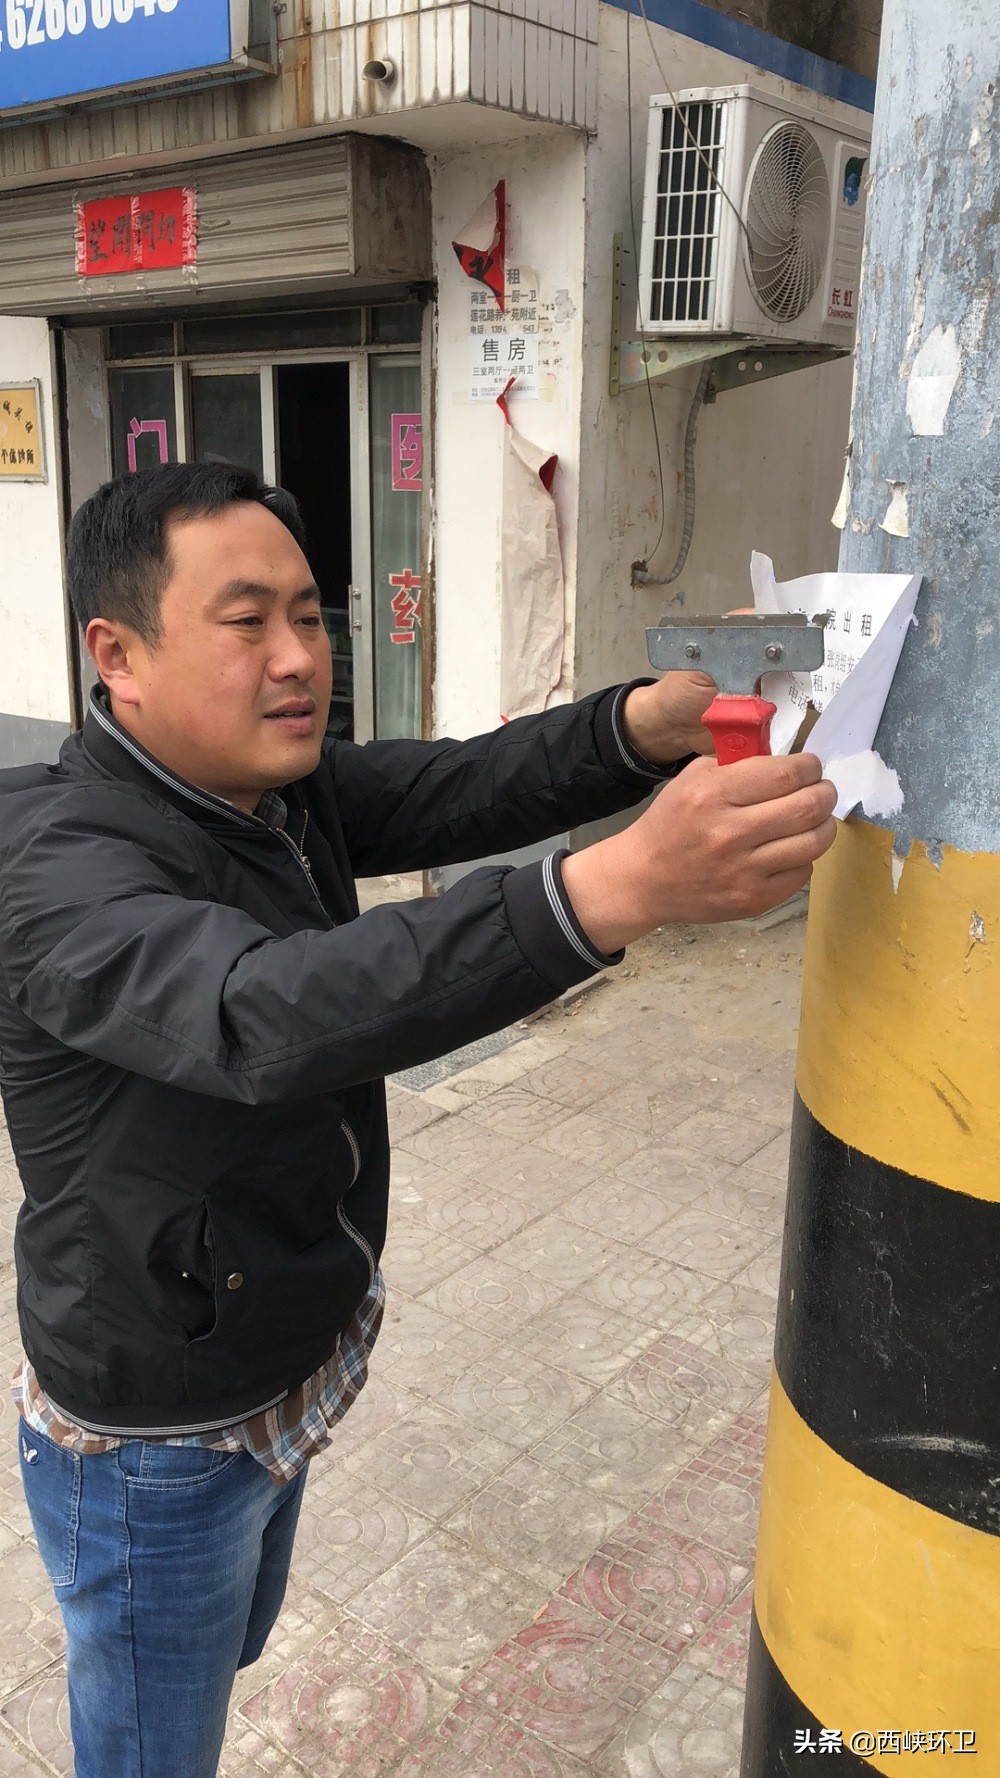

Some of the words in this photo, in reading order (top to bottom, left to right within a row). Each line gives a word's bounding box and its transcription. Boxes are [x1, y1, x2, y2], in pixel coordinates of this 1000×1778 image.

[470, 290, 537, 305] 两室一一厨一卫
[832, 288, 853, 307] 长虹
[828, 307, 854, 319] CHANGHONG
[482, 338, 526, 362] 售房
